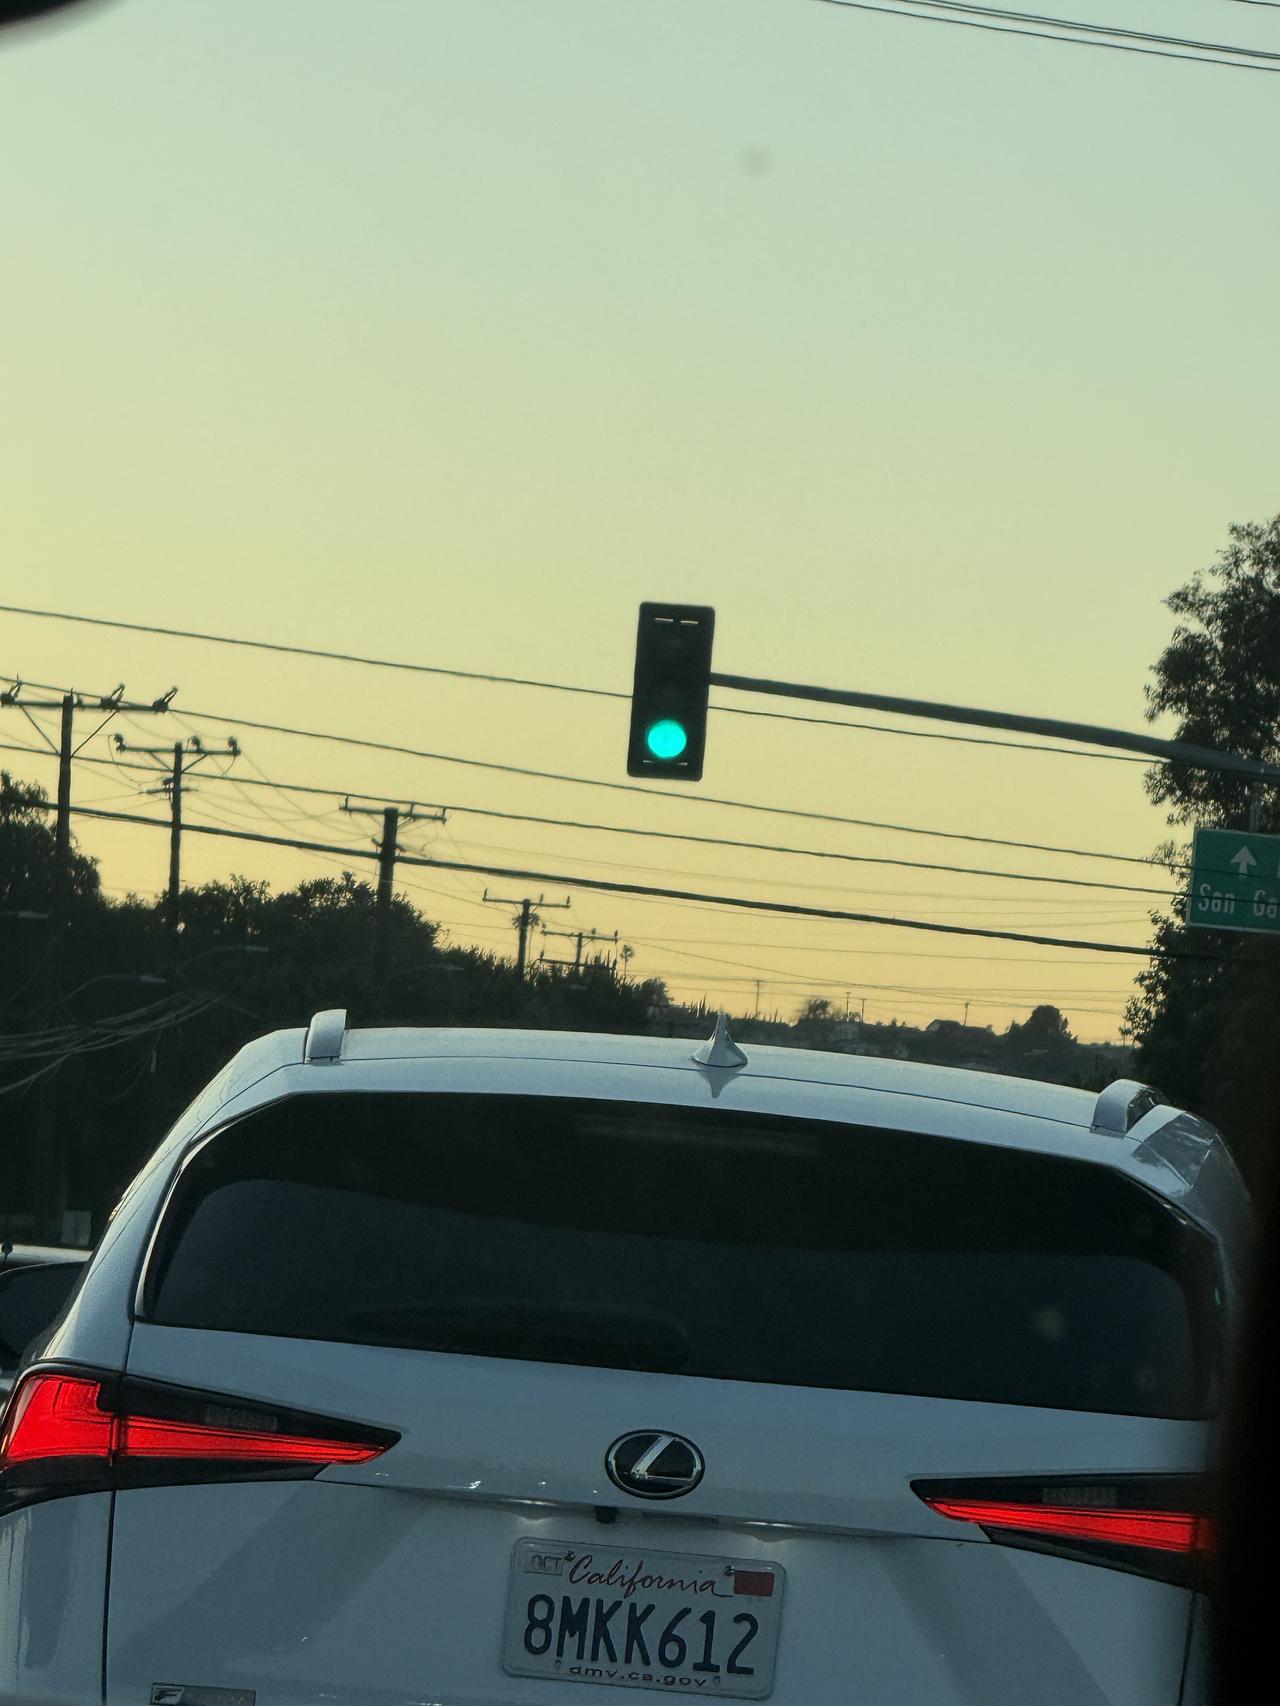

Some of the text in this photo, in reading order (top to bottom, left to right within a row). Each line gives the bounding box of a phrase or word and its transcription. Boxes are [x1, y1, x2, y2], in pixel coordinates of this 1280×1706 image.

[1198, 883, 1236, 914] San
[568, 1554, 734, 1599] California
[523, 1593, 759, 1675] 8MKK612
[569, 1664, 707, 1687] dmv.ca.gov
